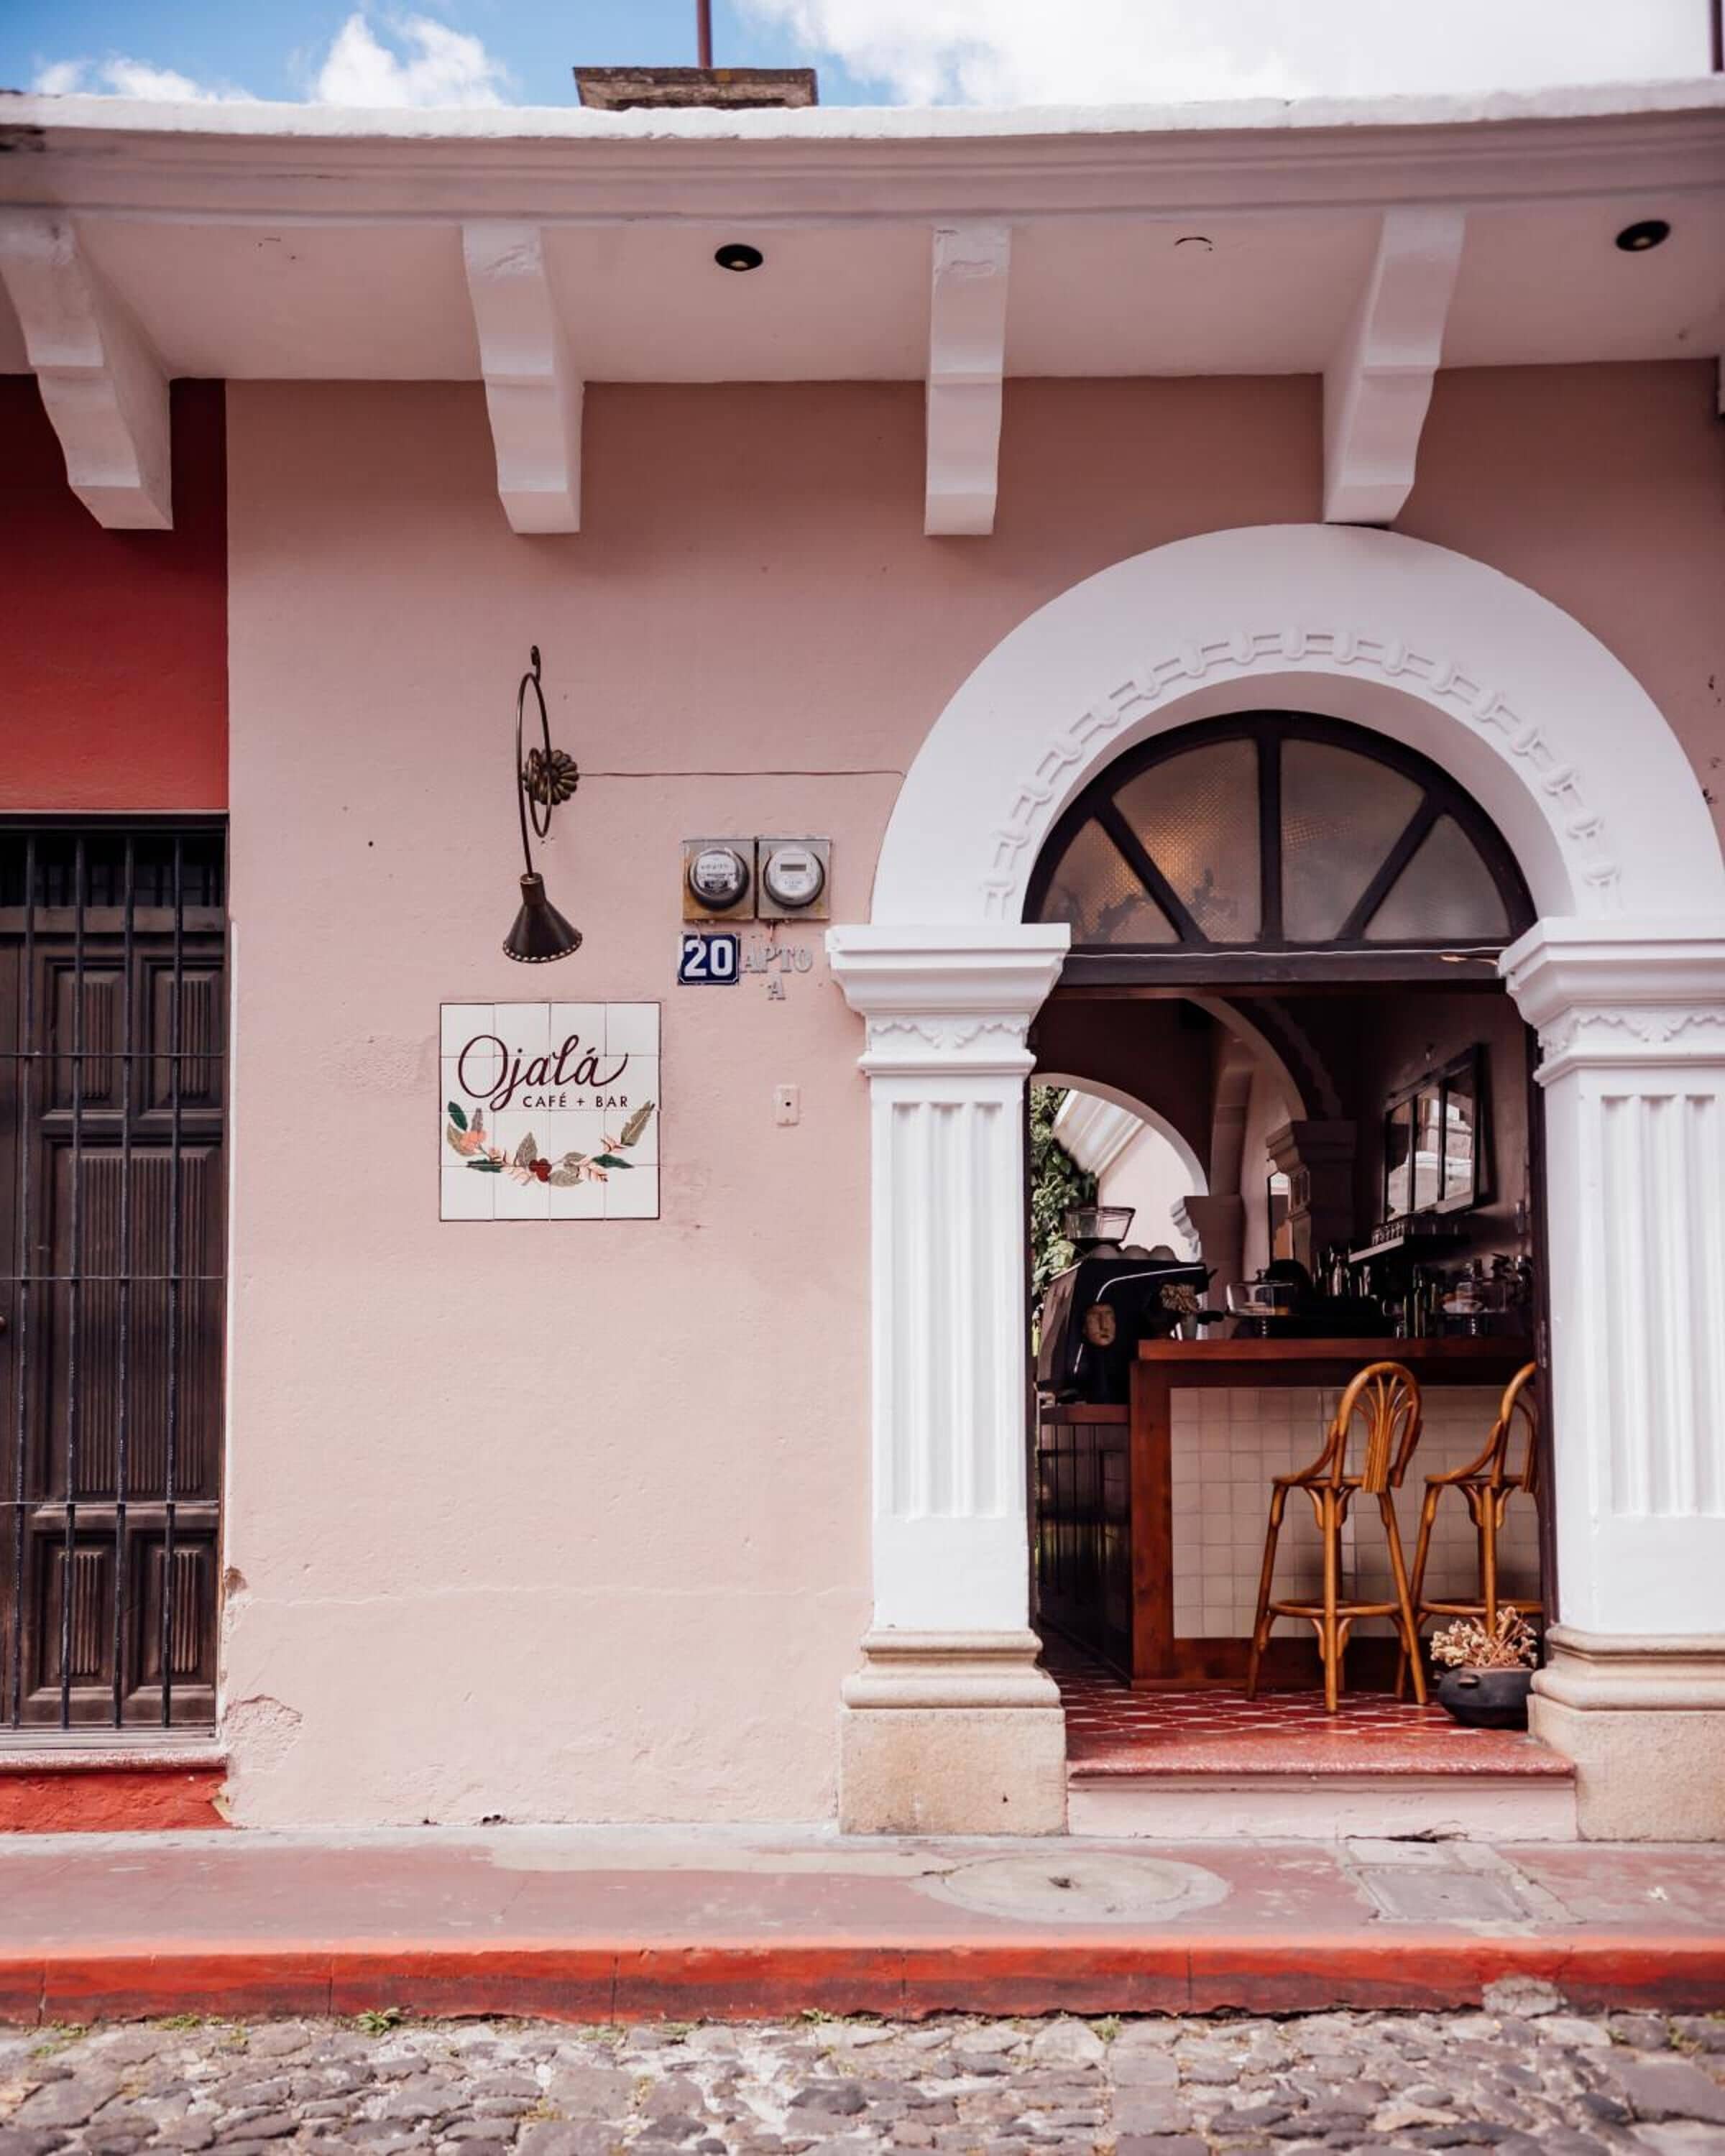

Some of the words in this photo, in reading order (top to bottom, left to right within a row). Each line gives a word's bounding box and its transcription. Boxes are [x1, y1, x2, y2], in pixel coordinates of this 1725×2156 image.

[684, 939, 734, 977] 20
[457, 1034, 630, 1112] Ojalá
[523, 1092, 567, 1108] CAFÉ
[595, 1096, 628, 1107] BAR
